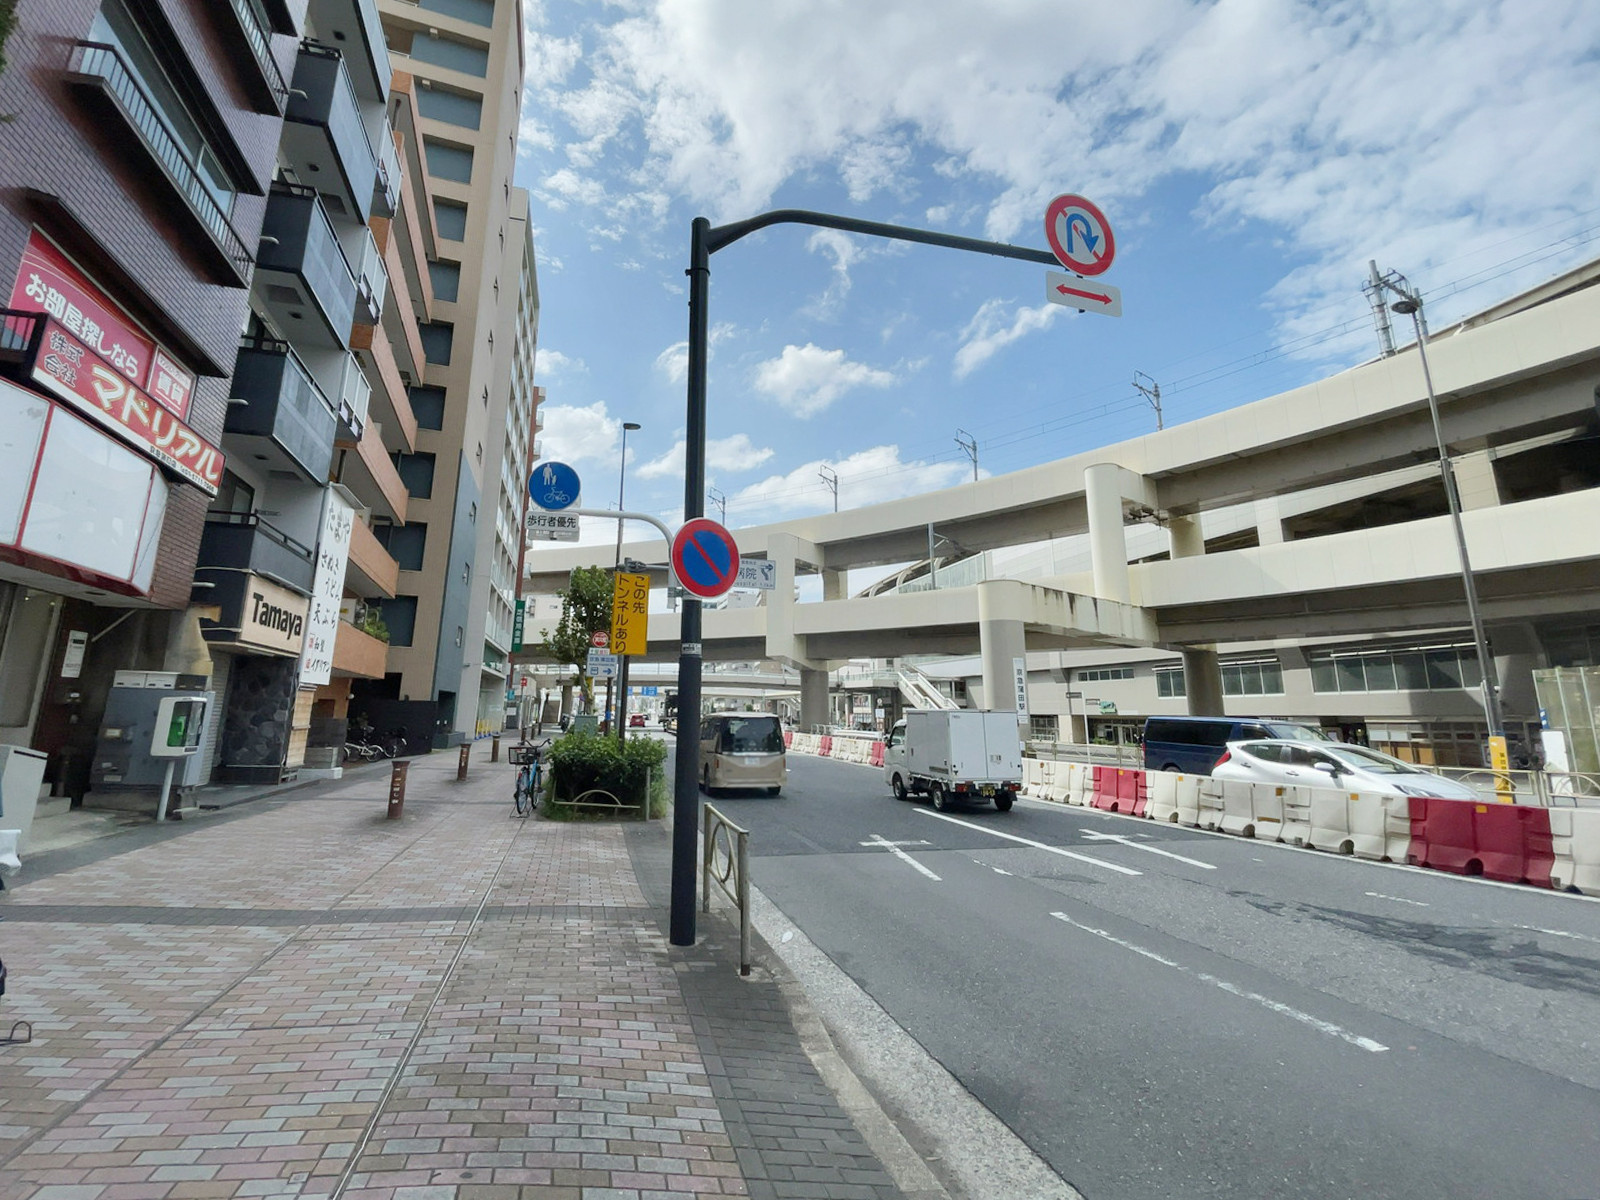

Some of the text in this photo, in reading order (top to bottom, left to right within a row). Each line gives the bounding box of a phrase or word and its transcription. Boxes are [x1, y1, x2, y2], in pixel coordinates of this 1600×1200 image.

[25, 272, 139, 378] お部屋探しなら
[50, 330, 85, 368] 株式
[43, 353, 77, 388] 会社
[157, 370, 185, 405] 賃貸
[91, 363, 219, 481] マドリアル
[527, 514, 577, 528] 歩行者優先
[633, 575, 647, 614] この先
[251, 591, 303, 640] Tamaya
[613, 575, 630, 654] トンネルあり
